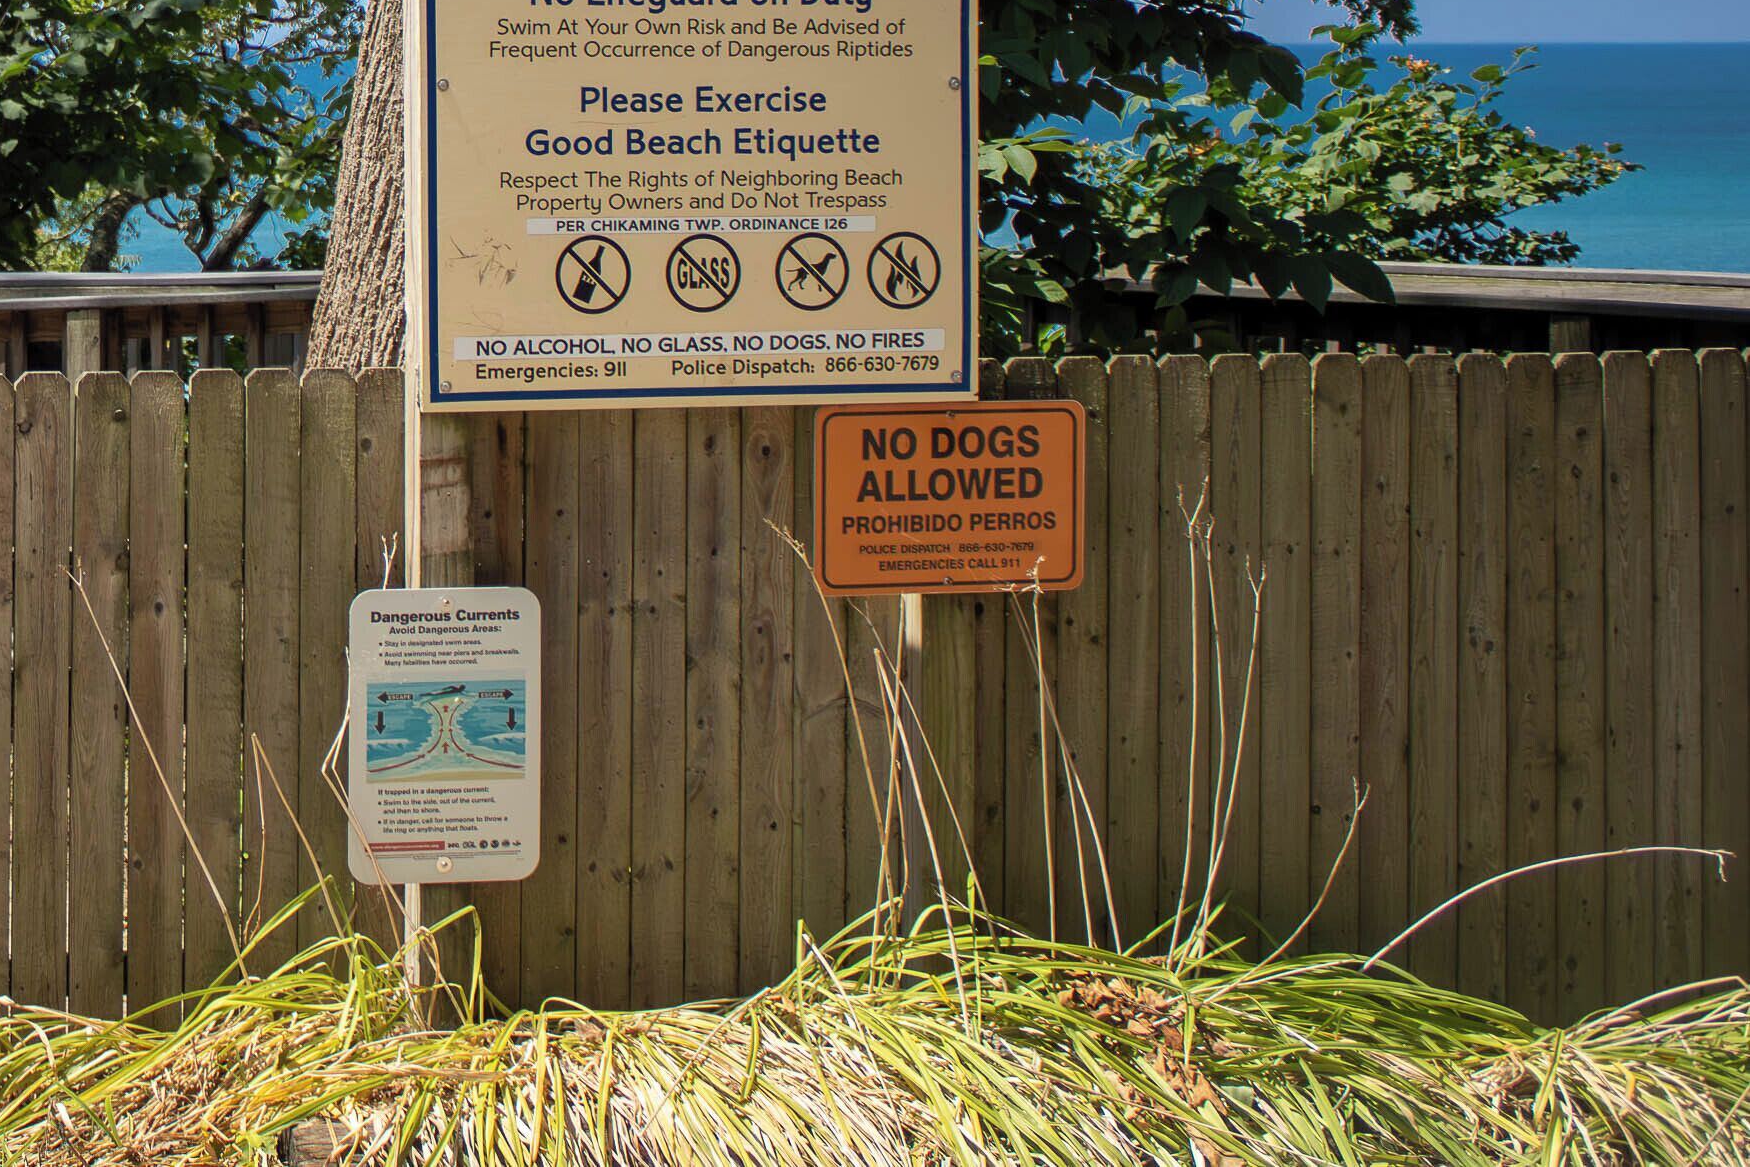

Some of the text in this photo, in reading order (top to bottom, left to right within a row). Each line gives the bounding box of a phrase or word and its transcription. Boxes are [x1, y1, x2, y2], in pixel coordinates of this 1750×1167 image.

[497, 17, 906, 35] Swim At Your Own Risk and Be Advised of
[489, 40, 914, 62] Frequent Occurrence of Dangerous Riptides
[580, 85, 826, 113] Please Exercise
[525, 126, 880, 162] Good Beach Etiquette
[500, 168, 902, 191] Respect The Rights of Neighboring Beach
[516, 190, 887, 216] Property Owners and Do Not Trespass
[556, 217, 848, 232] PER CHIKAMING TWP. ORDINANCE 126
[677, 257, 730, 289] GLASS
[476, 331, 925, 356] NO ALCOHOL, NO GLASS, NO DOGS, NO FIRES
[475, 361, 626, 383] Emergencies: 911
[671, 354, 939, 379] Police Dispatch: 866-630-7679
[861, 424, 1040, 461] NO DOGS
[856, 466, 1043, 502] ALLOWED
[841, 510, 1056, 534] PROHIBIDO PERROS
[858, 541, 1034, 554] POLICE DISPATCH 866-630-7679
[878, 557, 1020, 571] EMERGENCIES CALL 911
[370, 608, 520, 624] Dangerous Currents
[388, 624, 502, 635] Avoid Dangerous Areas:
